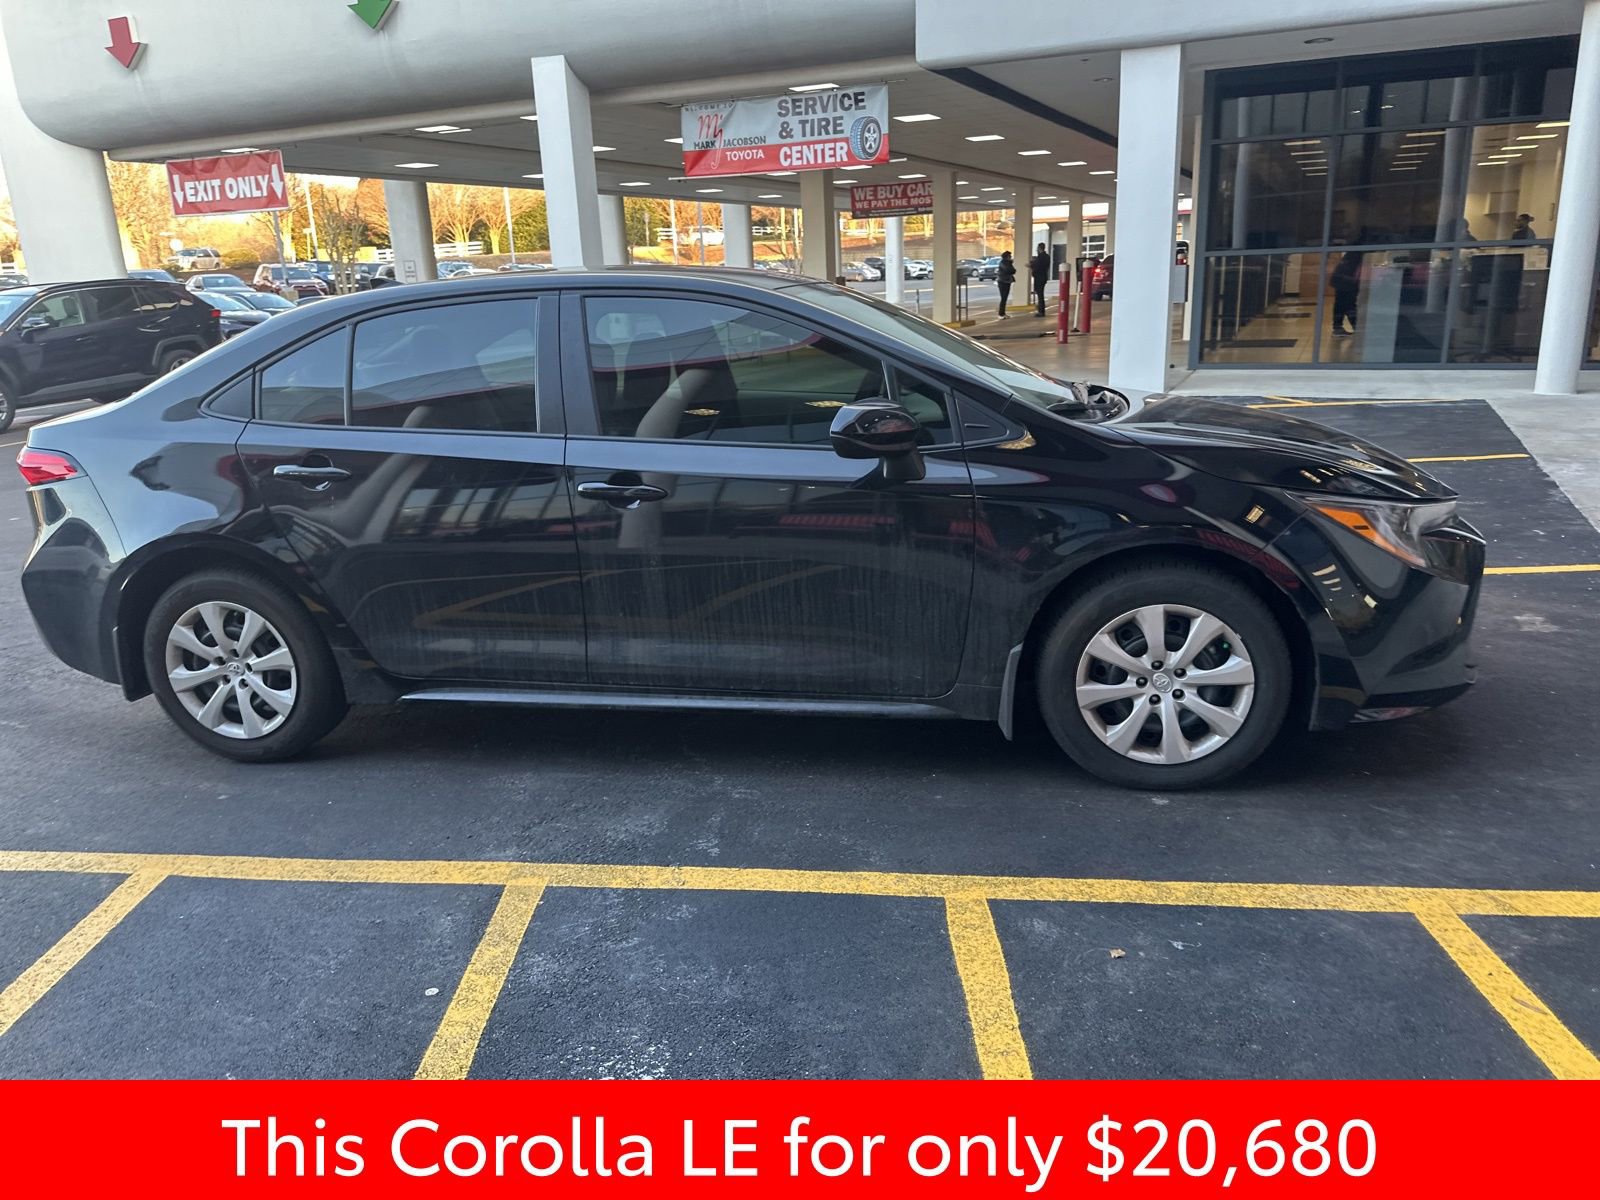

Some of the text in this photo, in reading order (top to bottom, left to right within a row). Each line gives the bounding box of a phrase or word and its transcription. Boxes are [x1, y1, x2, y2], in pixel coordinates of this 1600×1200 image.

[777, 91, 866, 118] SERVICE
[778, 115, 844, 140] & TIRE
[694, 136, 767, 150] MARK JACOBSON
[725, 149, 765, 161] TOYOTA
[779, 141, 849, 167] CENTER
[184, 174, 270, 203] EXIT ONLY
[853, 187, 875, 201] WE
[877, 185, 905, 198] BUY
[855, 196, 934, 209] WE PAY THE MOS
